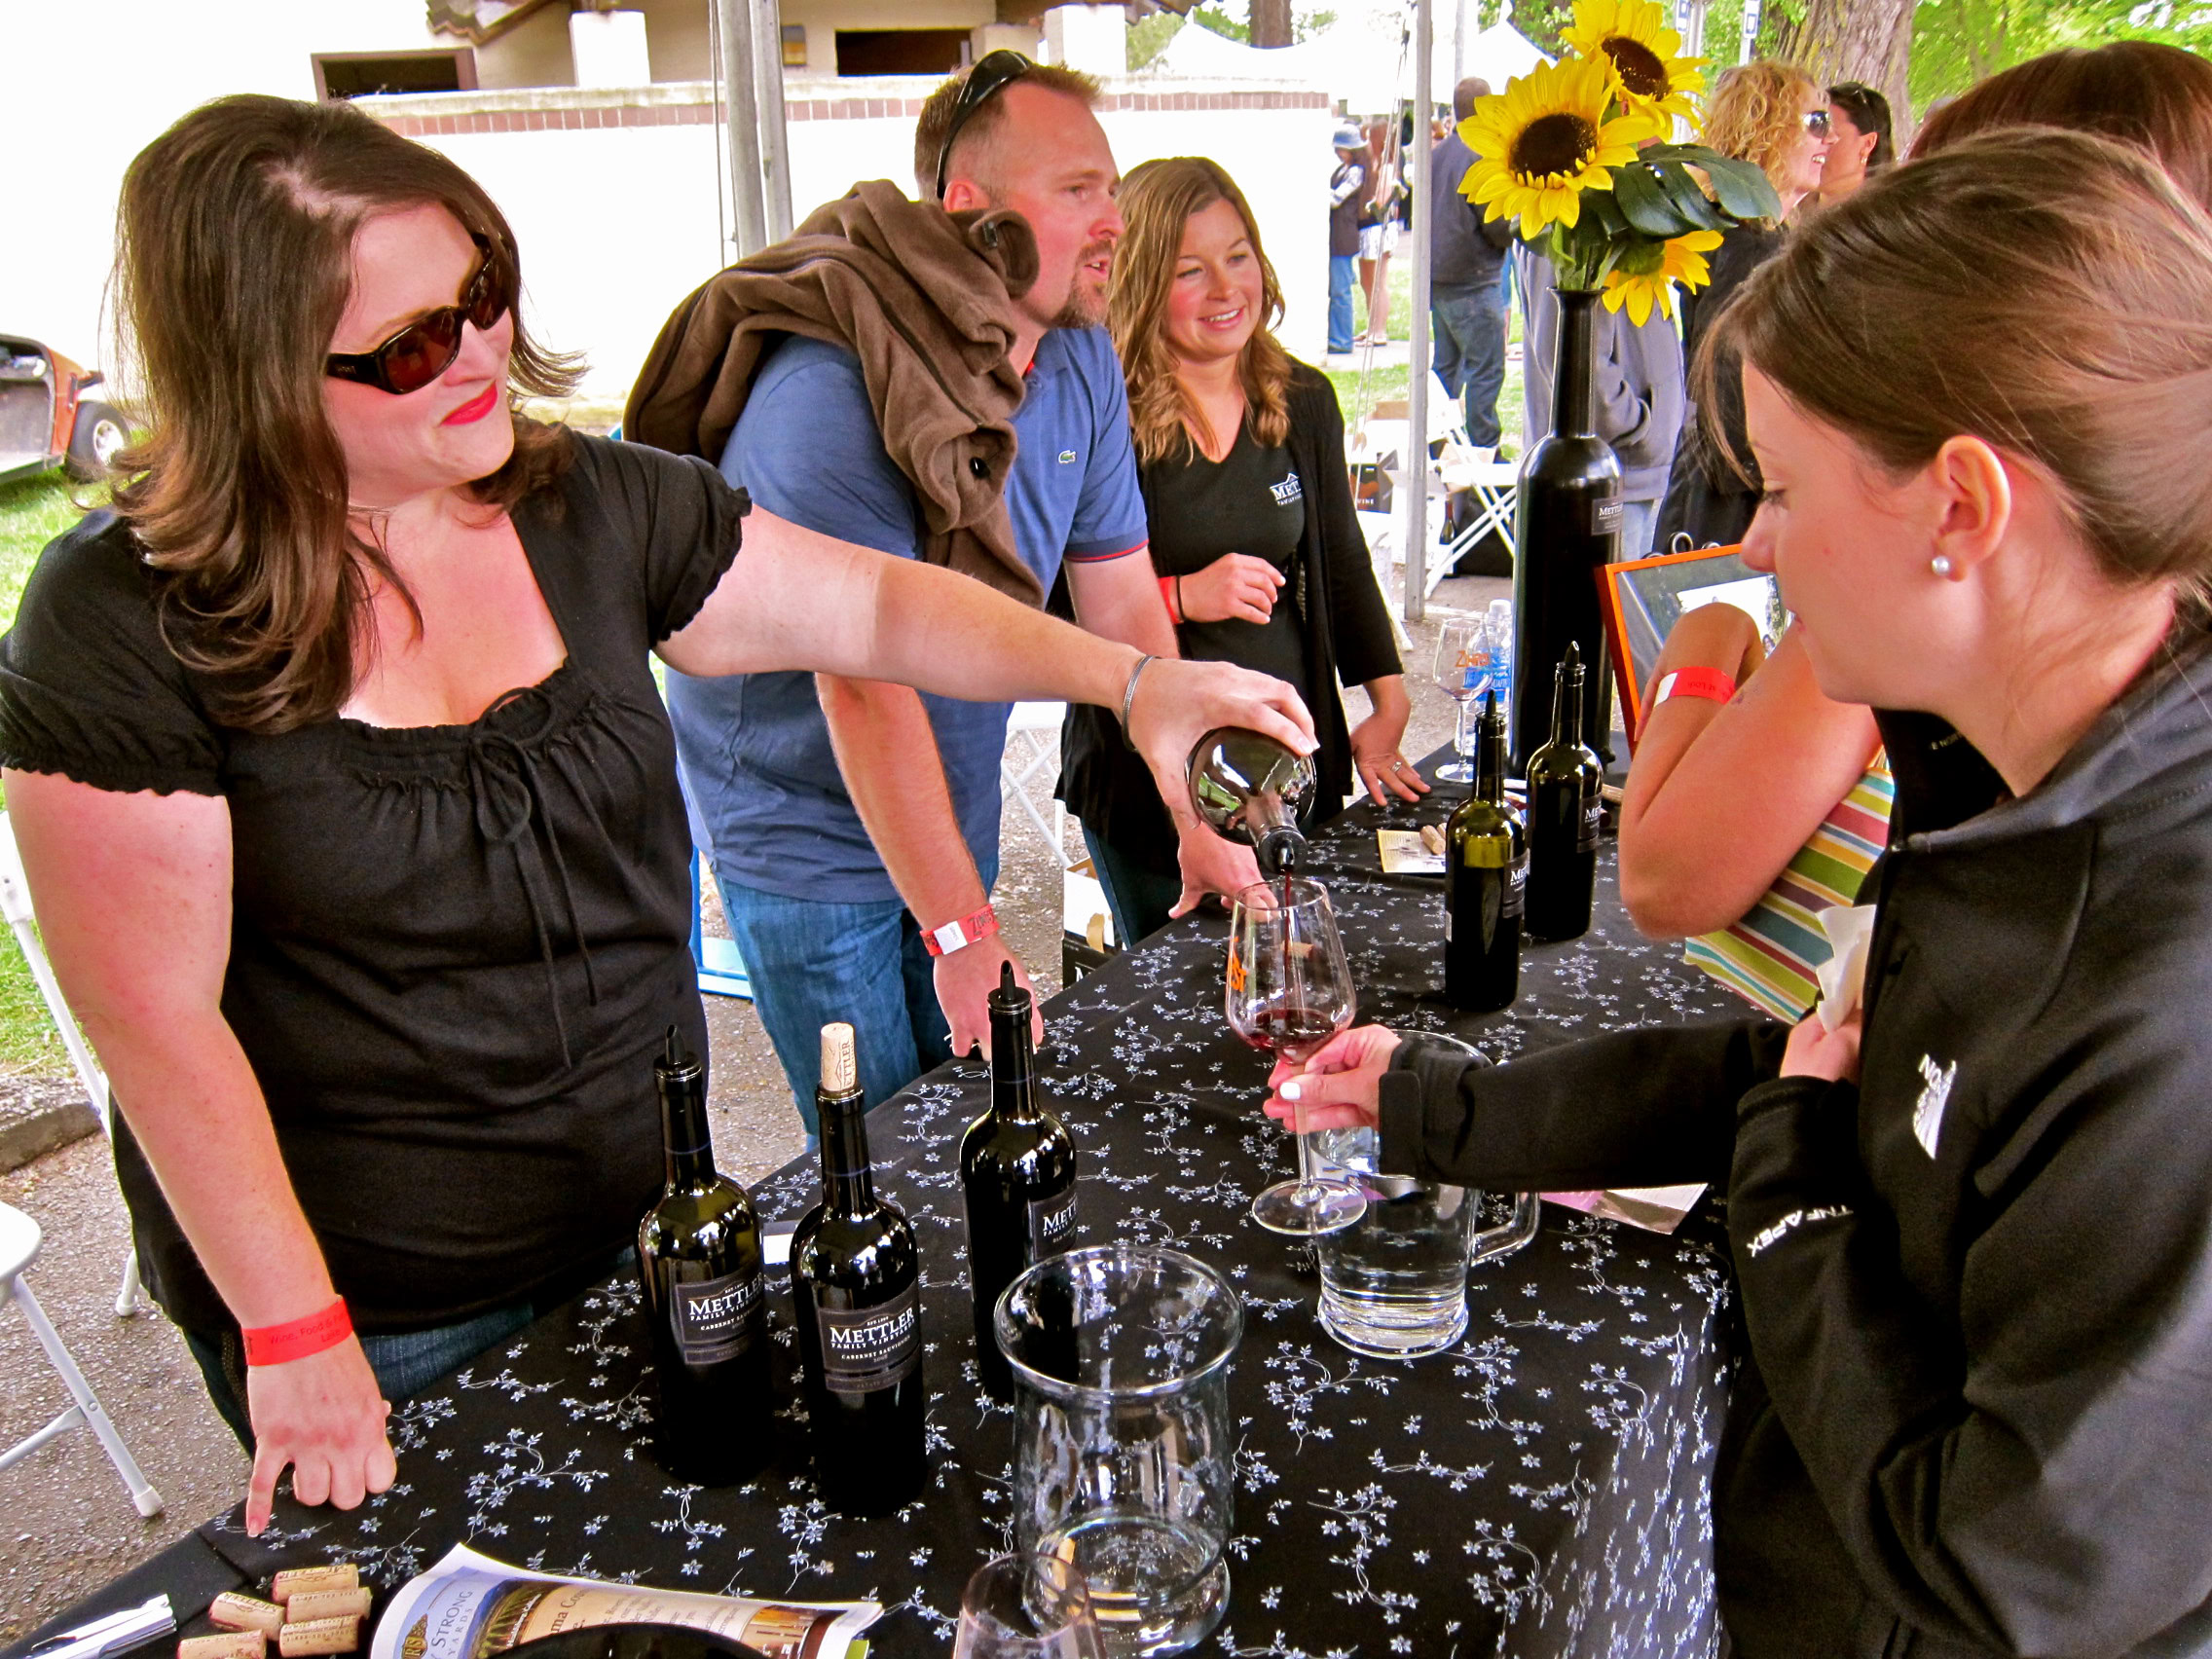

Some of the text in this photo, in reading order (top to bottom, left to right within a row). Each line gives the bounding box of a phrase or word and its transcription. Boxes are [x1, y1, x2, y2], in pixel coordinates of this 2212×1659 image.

[1271, 481, 1302, 500] MET
[841, 1039, 853, 1088] ETTLER
[1747, 1204, 1854, 1258] TNF APEX
[690, 1310, 725, 1321] FAMILY
[700, 1317, 735, 1331] CABERNET
[830, 1307, 914, 1345] METTLER
[271, 1333, 299, 1346] Wine,
[299, 1319, 324, 1337] Food
[872, 1317, 915, 1346] VINEYARDS
[879, 1335, 911, 1355] SAUVIGNON
[431, 1590, 473, 1649] STRONG
[447, 1607, 473, 1656] YARDS
[550, 1610, 569, 1634] ma
